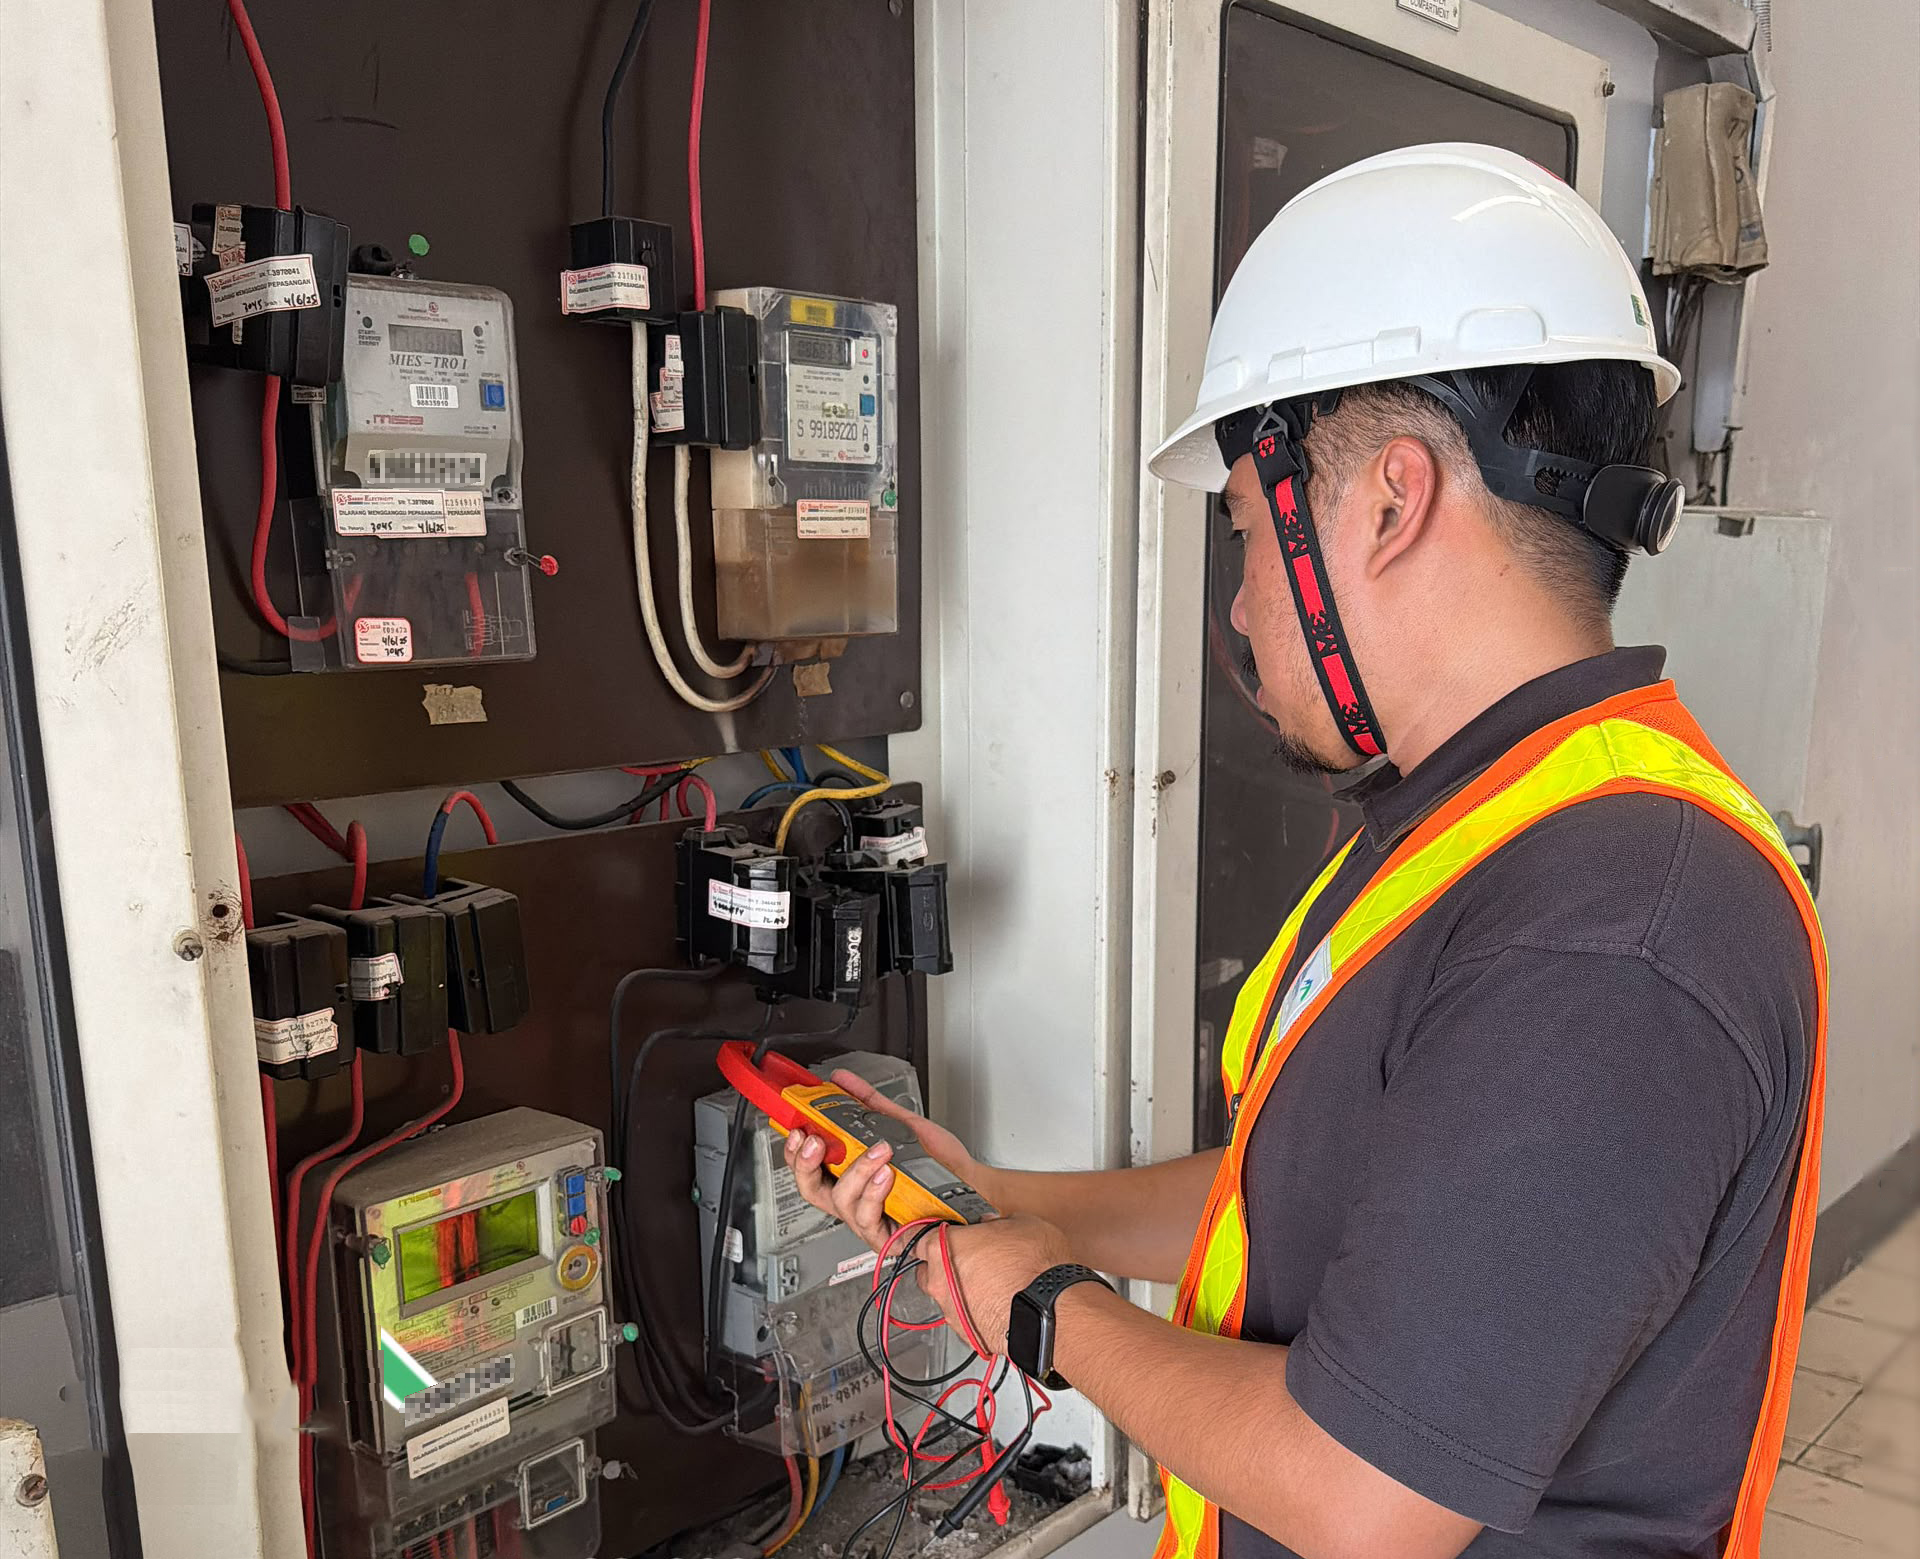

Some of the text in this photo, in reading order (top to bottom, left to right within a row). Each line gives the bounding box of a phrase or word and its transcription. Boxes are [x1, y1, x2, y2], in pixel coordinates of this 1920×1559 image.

[268, 279, 312, 288] PEPASANGAN
[797, 419, 869, 442] S 99189220 A
